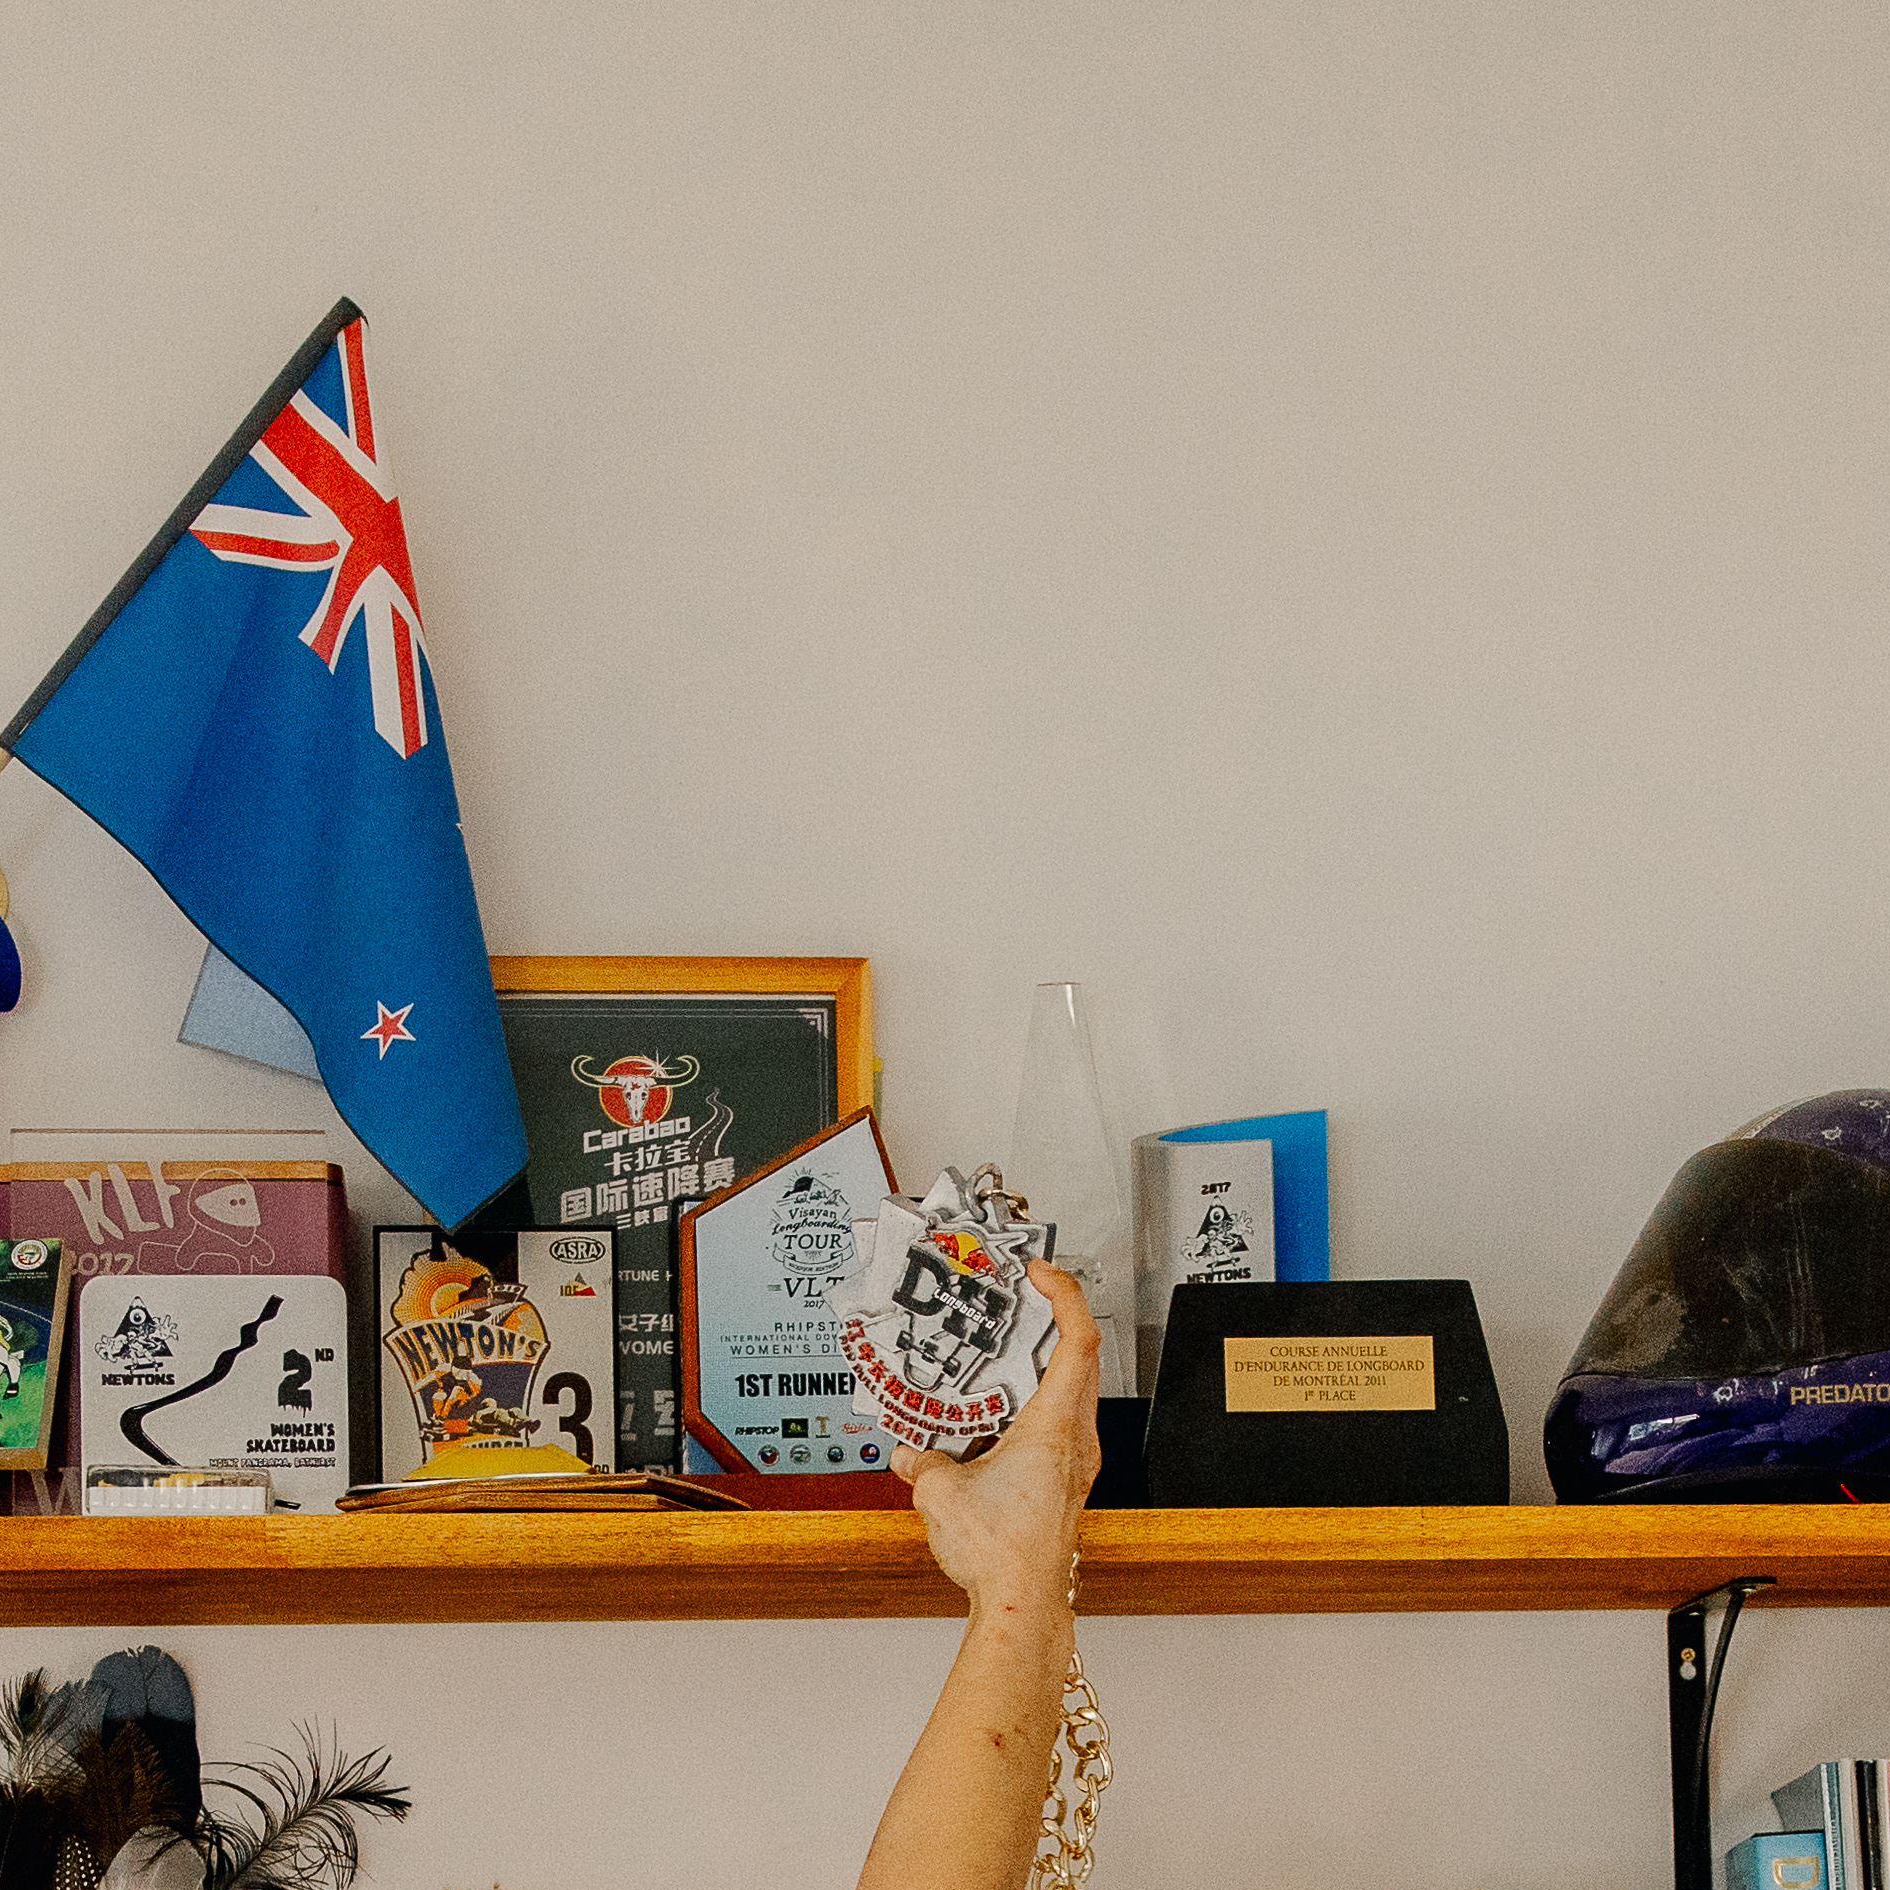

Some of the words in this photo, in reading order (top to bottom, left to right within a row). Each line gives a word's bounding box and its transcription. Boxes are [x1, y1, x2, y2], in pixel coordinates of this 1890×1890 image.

[583, 1116, 691, 1154] Carabao
[604, 1139, 691, 1177] 卡拉宝
[561, 1157, 736, 1224] 国际速降赛
[788, 1207, 837, 1220] Visayan
[772, 1218, 851, 1235] Longboarding
[558, 1240, 598, 1259] ASRA
[783, 1234, 843, 1250] TOUR
[1187, 1267, 1251, 1284] NEWTONS
[803, 1300, 826, 1309] 2017
[934, 1287, 997, 1330] Longboard
[720, 1333, 809, 1343] INTERNATIONAL
[395, 1323, 543, 1386] NEWTON'S
[730, 1344, 811, 1356] WOMEN'S
[1270, 1346, 1319, 1358] COURSE
[1322, 1345, 1388, 1358] ANNUELLE
[1234, 1360, 1324, 1373] D'ENDURANCE
[1327, 1361, 1344, 1372] DE
[1347, 1360, 1425, 1373] LONGBOARD
[102, 1373, 176, 1386] NEWTONS
[735, 1373, 773, 1397] 1ST
[1273, 1375, 1290, 1387] DE
[1293, 1373, 1362, 1387] MONTRÉAL
[1364, 1375, 1388, 1387] 2011
[1319, 1390, 1357, 1401] PLACE
[270, 1423, 335, 1437] WOMEN'S
[246, 1438, 336, 1453] SKATEBOARD
